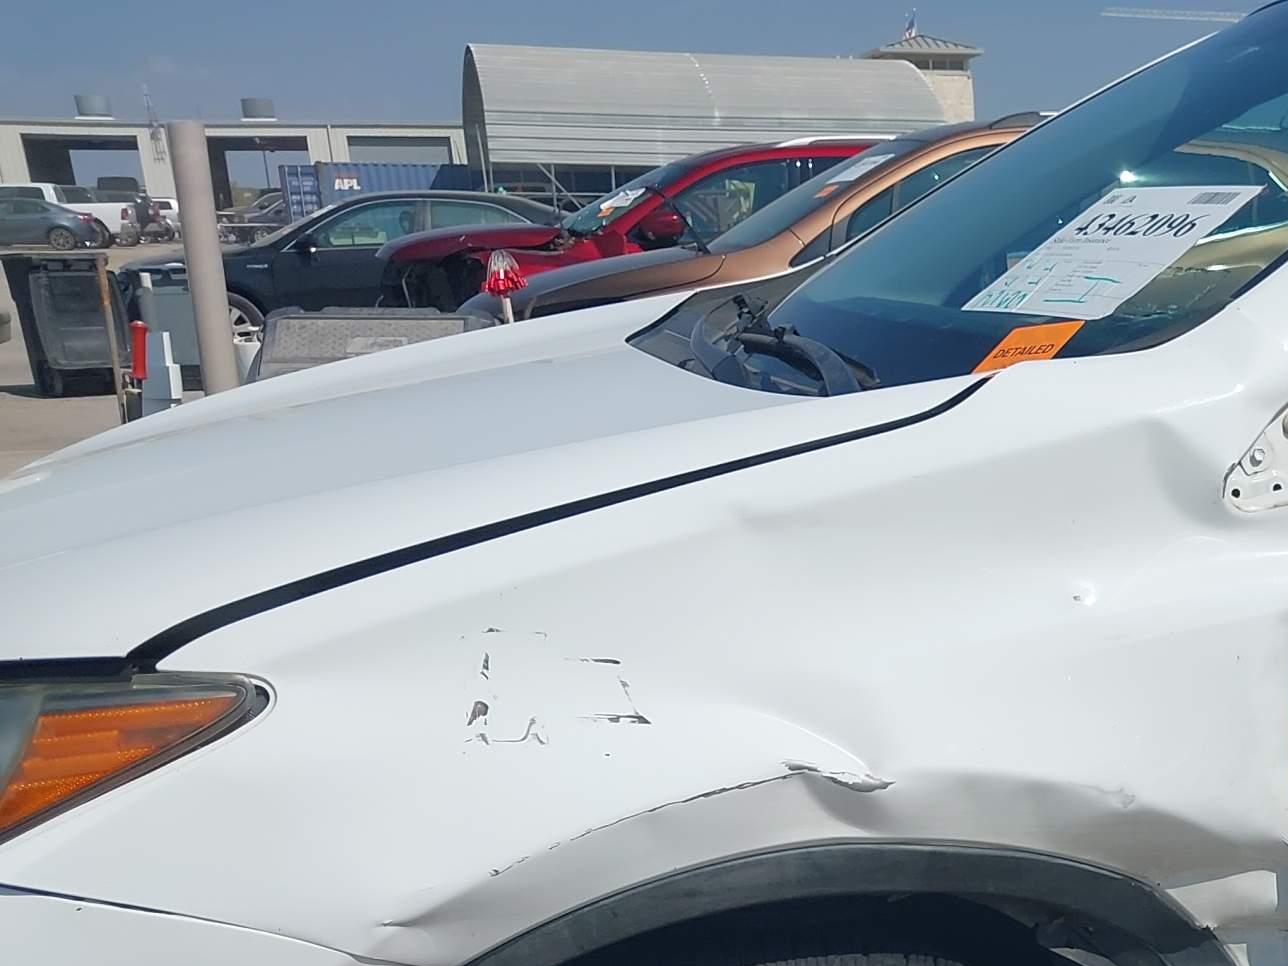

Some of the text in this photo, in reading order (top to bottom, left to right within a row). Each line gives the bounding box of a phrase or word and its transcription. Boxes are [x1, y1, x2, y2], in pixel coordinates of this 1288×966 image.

[334, 178, 361, 190] APL
[1074, 213, 1211, 238] 43462096
[993, 343, 1055, 359] DETAILED
